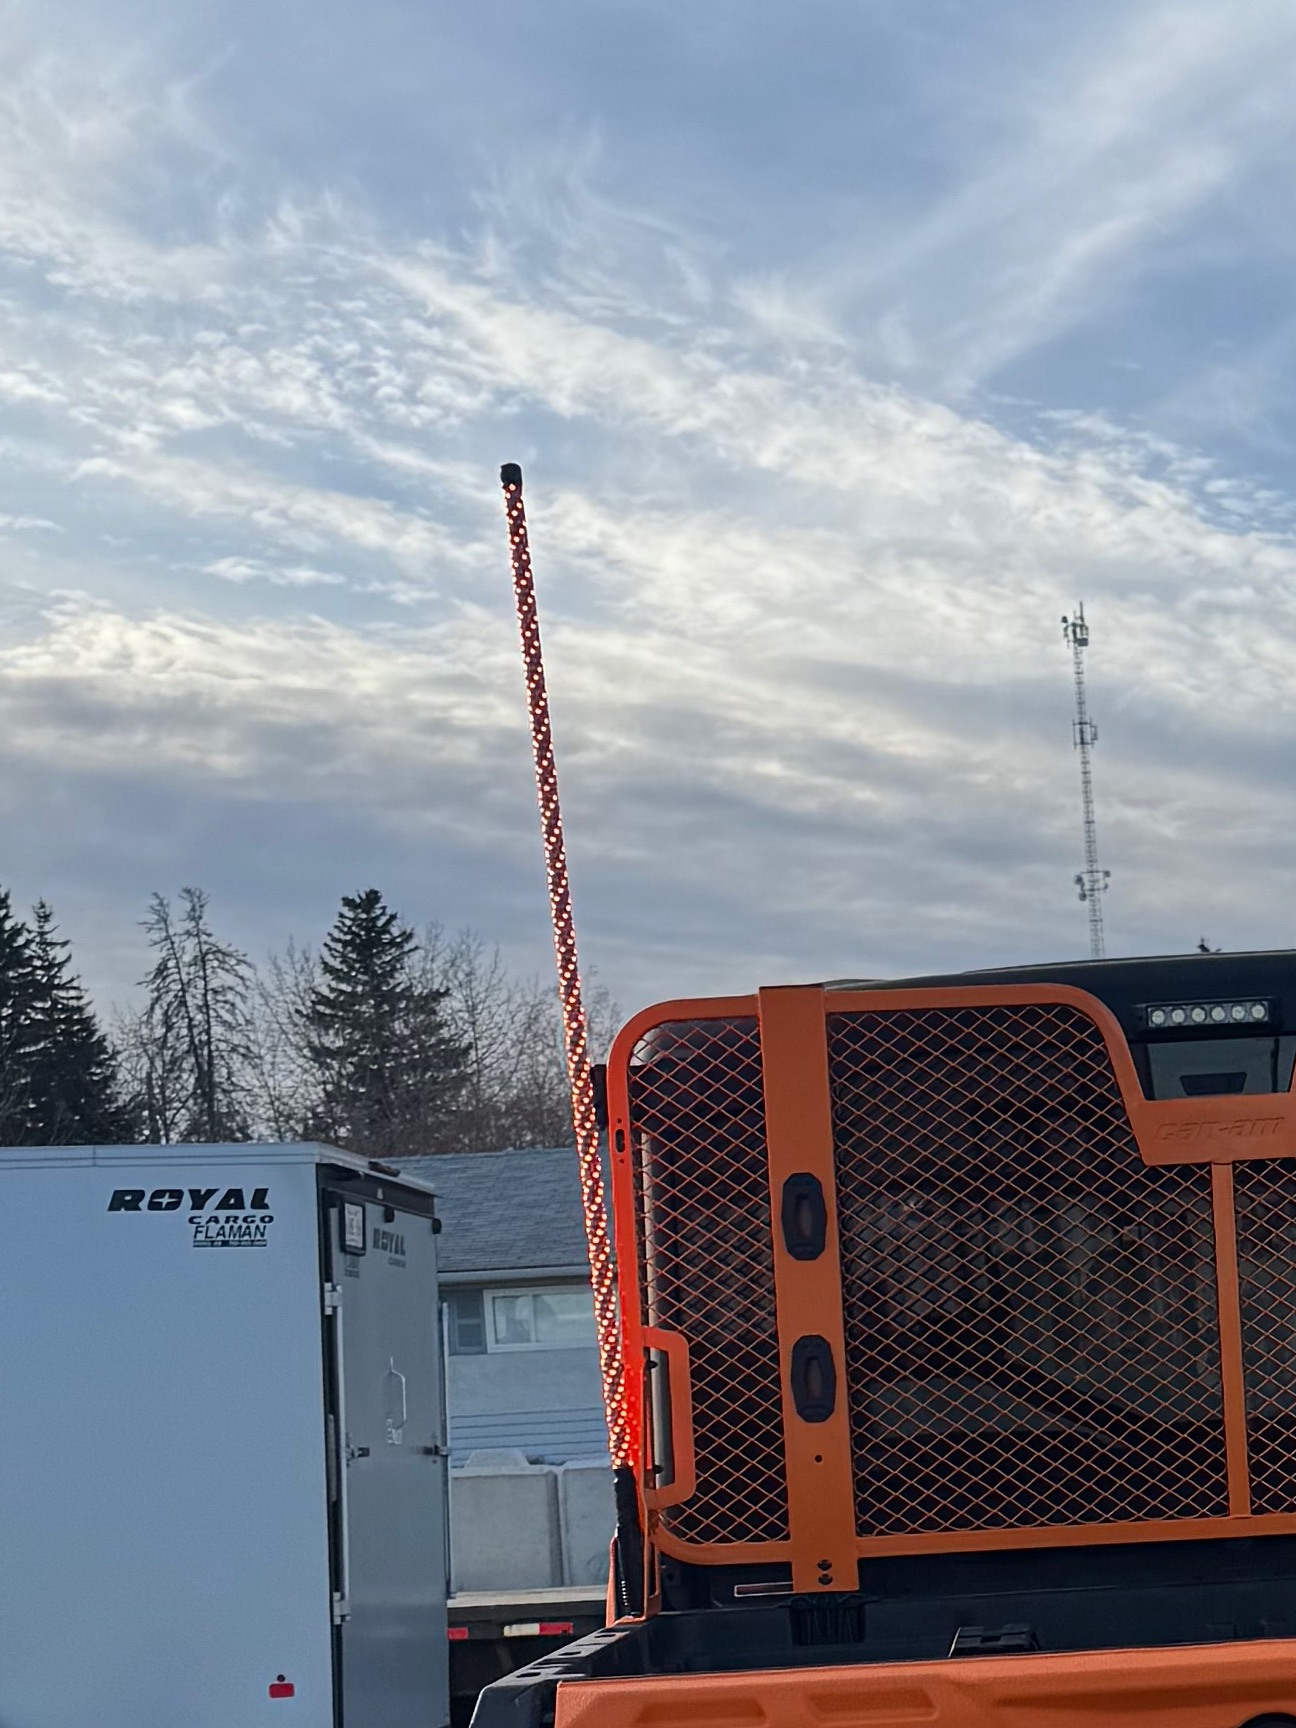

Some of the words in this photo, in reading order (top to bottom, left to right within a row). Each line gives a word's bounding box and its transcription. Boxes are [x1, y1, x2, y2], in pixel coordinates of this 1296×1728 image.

[107, 1188, 270, 1211] ROYAL
[188, 1215, 274, 1225] CARGO
[193, 1225, 267, 1239] FLAMAN
